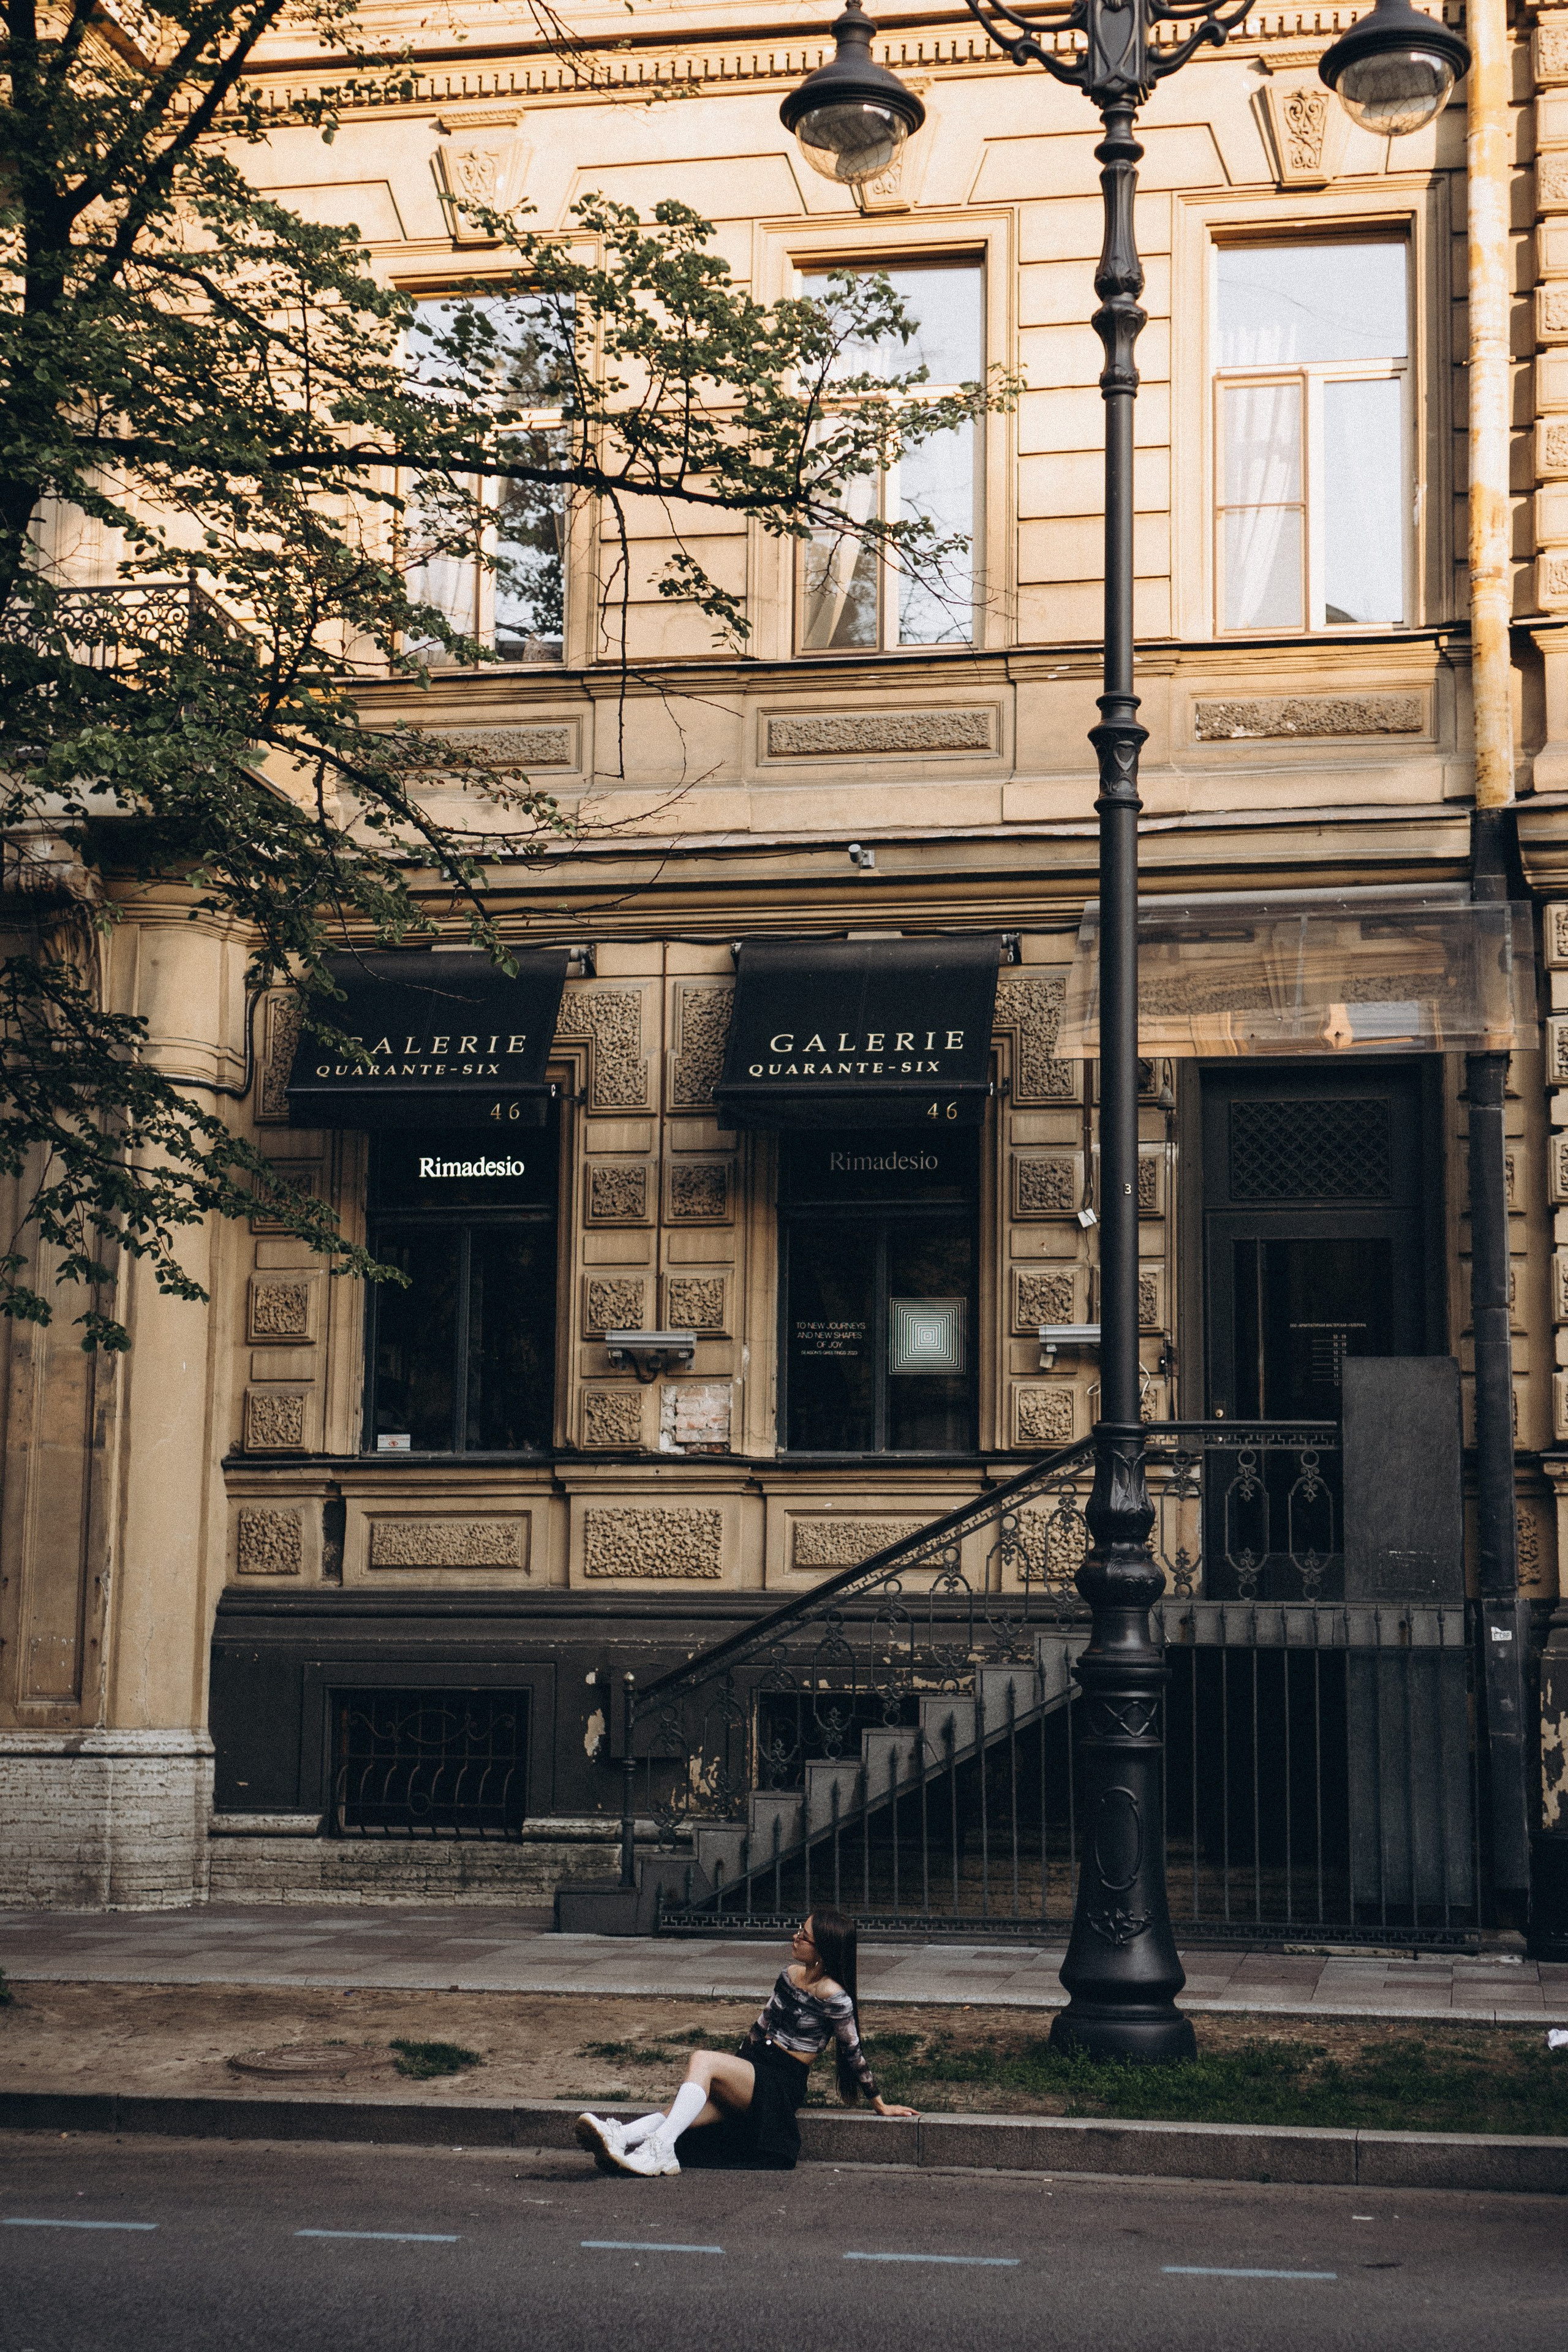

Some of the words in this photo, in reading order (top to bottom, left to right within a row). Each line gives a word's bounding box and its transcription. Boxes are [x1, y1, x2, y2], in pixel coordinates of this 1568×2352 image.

[770, 1030, 965, 1053] GALERIE
[315, 1063, 500, 1077] QUARANTE-SIX
[748, 1060, 940, 1077] QUARANTE-SIX
[490, 1102, 520, 1120] 46
[927, 1101, 958, 1120] 46
[419, 1156, 525, 1178] Rimadesio
[830, 1150, 938, 1170] Rimadesio
[1124, 1183, 1132, 1195] 3
